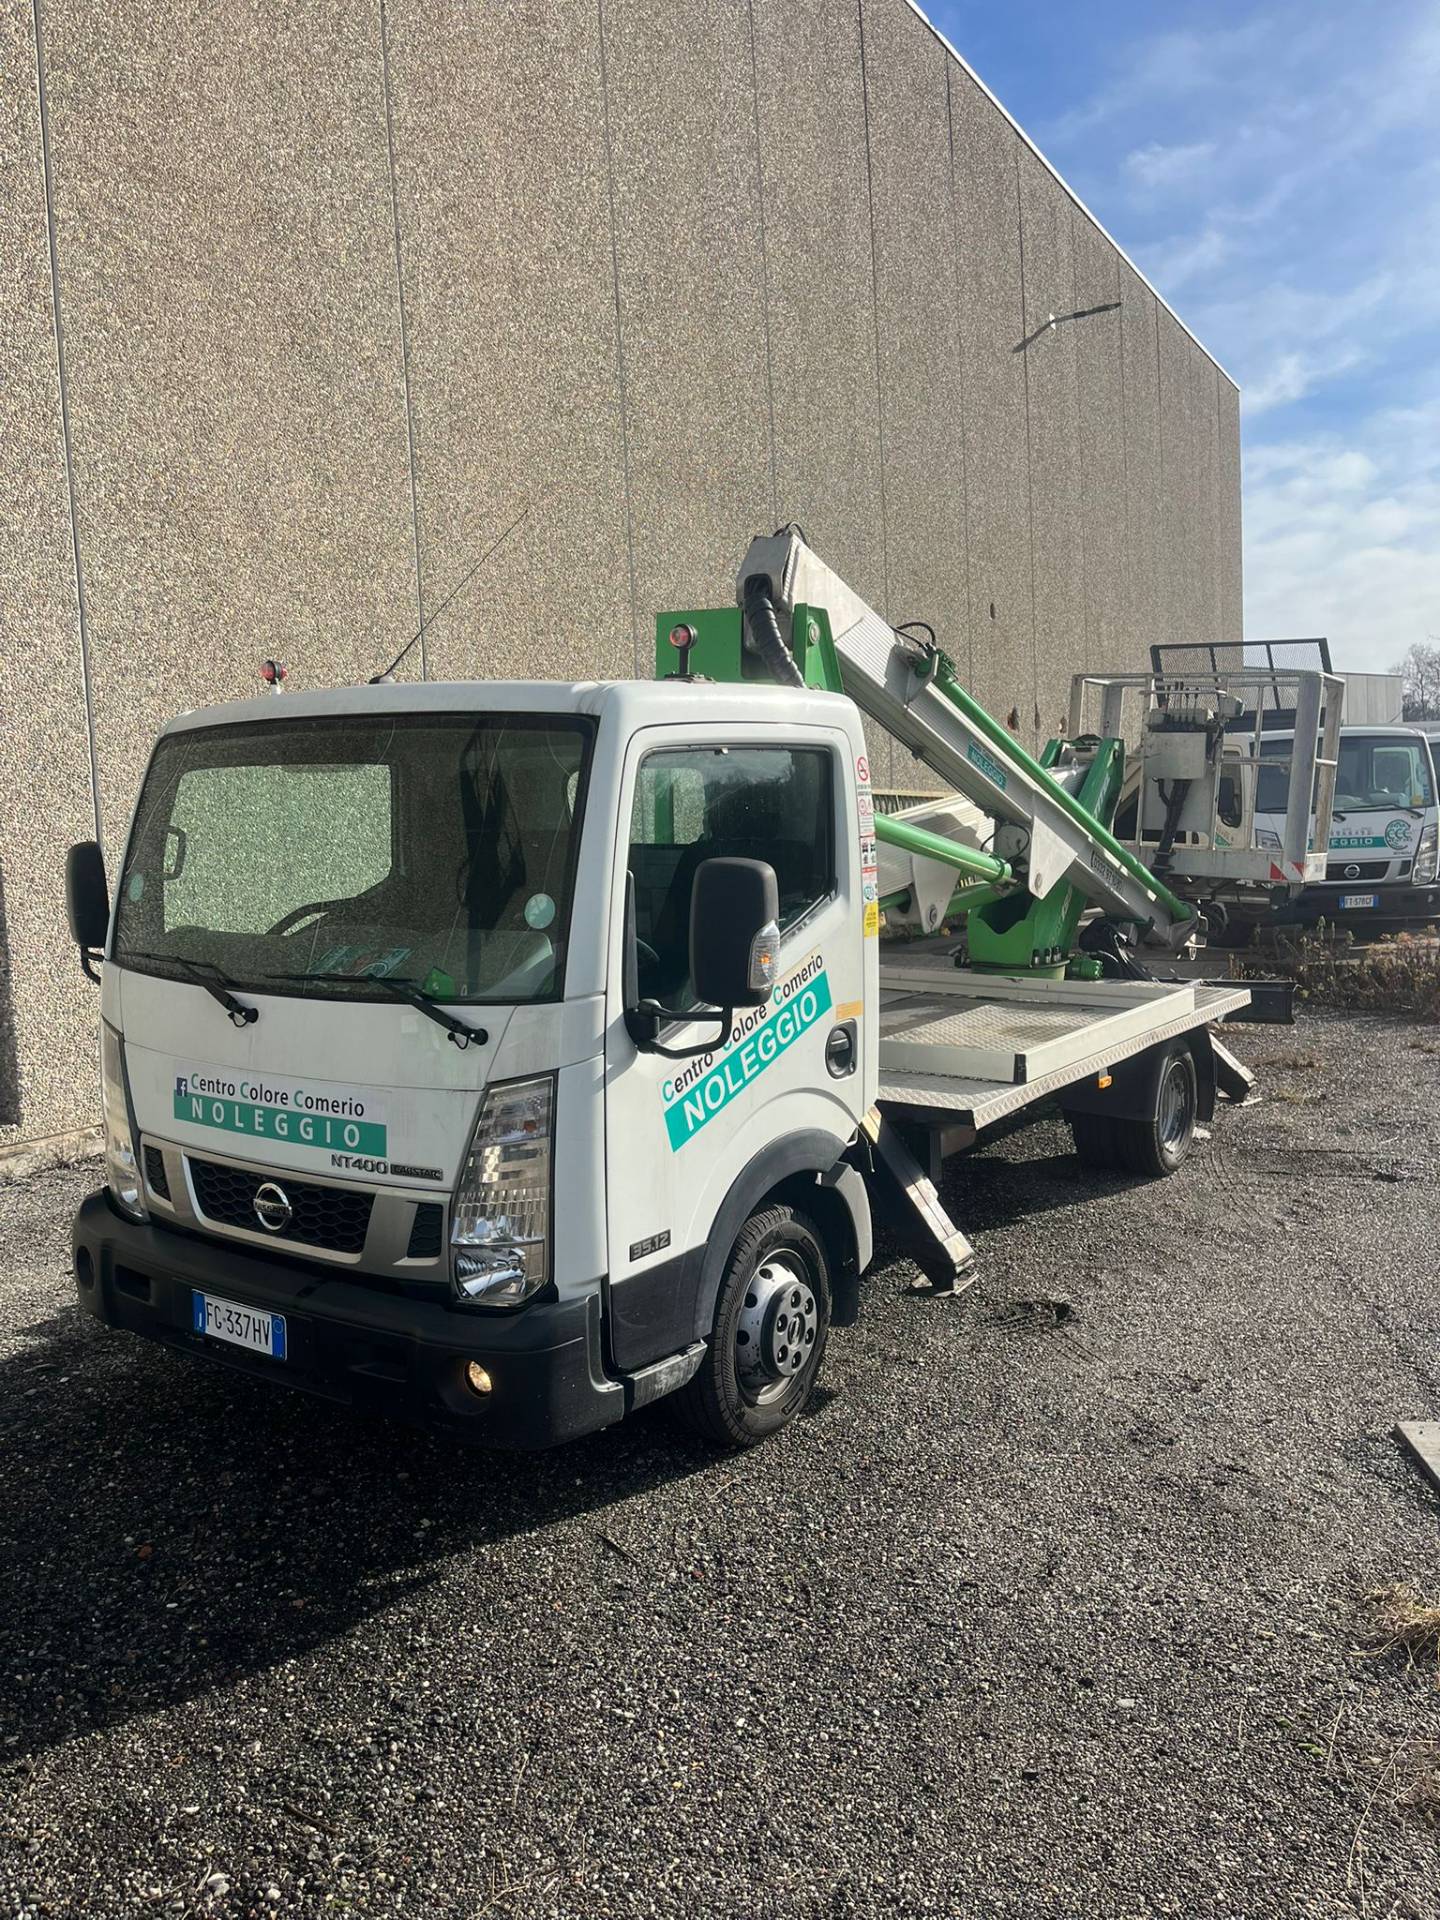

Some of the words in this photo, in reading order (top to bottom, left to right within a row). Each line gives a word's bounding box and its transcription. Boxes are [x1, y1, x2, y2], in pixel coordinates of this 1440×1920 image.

[662, 1052, 713, 1102] Centro
[773, 954, 823, 1006] Comerio
[683, 990, 818, 1132] NOLEGGIO
[191, 1073, 235, 1097] Centro
[240, 1081, 289, 1106] Colore
[294, 1090, 365, 1117] Comerio
[191, 1097, 360, 1148] NOLEGGIO
[331, 1154, 388, 1175] NT400
[632, 1232, 669, 1259] 35.12
